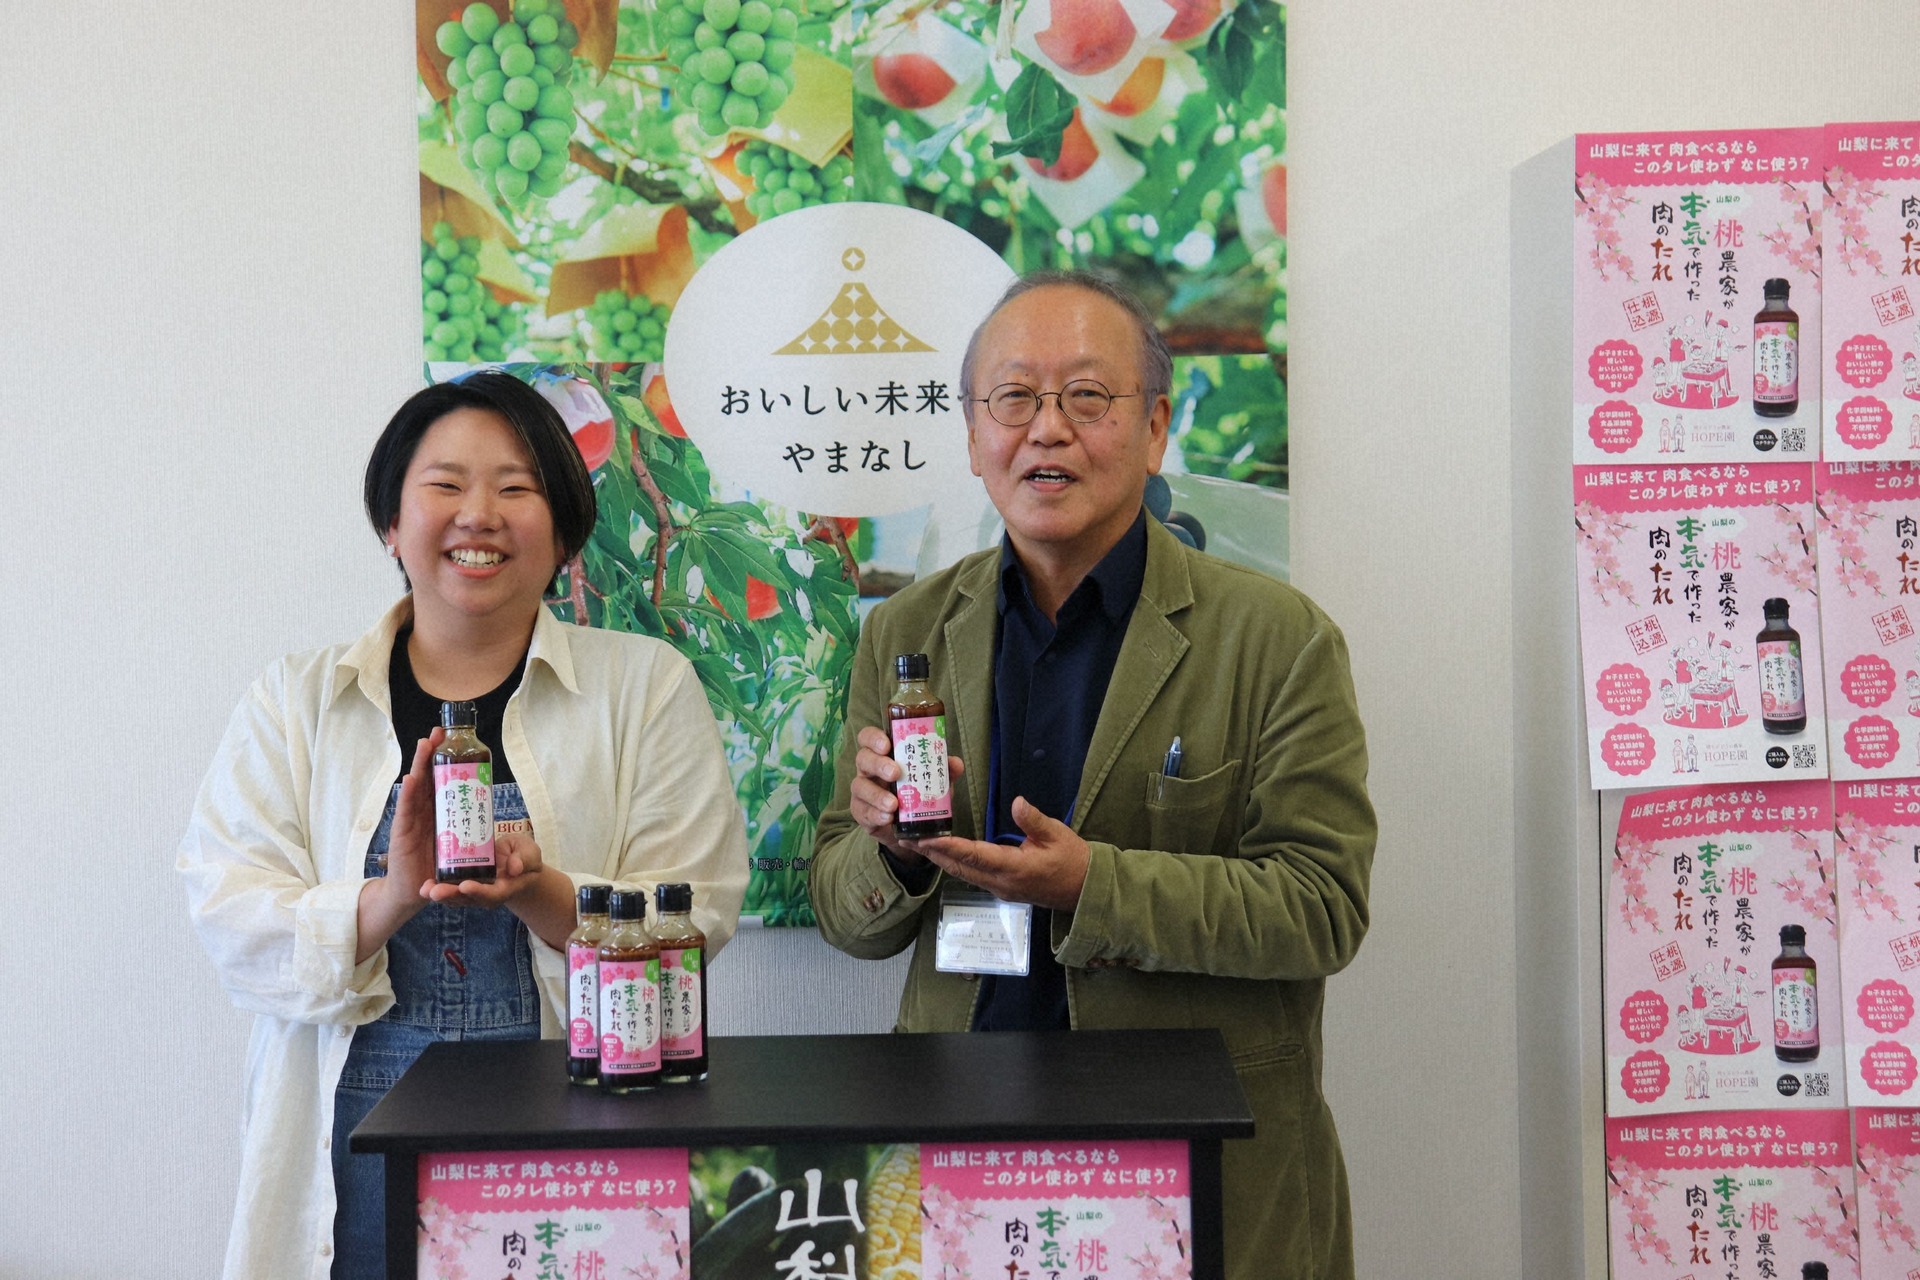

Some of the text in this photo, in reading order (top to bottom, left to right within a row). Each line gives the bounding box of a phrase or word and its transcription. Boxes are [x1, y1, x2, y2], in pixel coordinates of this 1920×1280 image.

[1590, 140, 1757, 158] 山梨に来て 肉食べるなら
[1838, 137, 1914, 152] 山梨に来て
[1633, 158, 1735, 174] このタレ使わず
[1716, 195, 1740, 204] 山梨の
[1650, 201, 1674, 282] 肉のたれ
[1680, 191, 1710, 301] 本気で作った
[1900, 195, 1920, 276] 肉のたれ
[1713, 218, 1745, 309] 桃農家が
[721, 381, 966, 416] おいしい未来
[783, 440, 926, 473] やまなし
[1584, 465, 1750, 486] 山梨に来て 肉食べるなら
[1629, 484, 1728, 500] このタレ使わず
[1711, 518, 1736, 527] 山梨の
[1649, 526, 1674, 605] 肉のたれ
[1896, 515, 1920, 595] 肉のたれ
[1676, 516, 1707, 623] 本気で作った
[1711, 542, 1741, 630] 桃農家が
[905, 743, 918, 783] 肉のたれ
[1704, 750, 1748, 761] HOPE園
[445, 789, 457, 829] 肉のたれ
[1631, 790, 1767, 819] 山梨に来て 肉食べるなら
[498, 822, 522, 833] BIG
[1661, 807, 1746, 828] このタレ使わず
[1729, 843, 1752, 851] 山梨の
[1673, 852, 1694, 931] 肉のたれ
[1697, 841, 1725, 949] 本気で作った
[1728, 867, 1758, 955] 桃農家が
[580, 973, 592, 1016] 肉のたれ
[610, 988, 622, 1031] 肉のたれ
[1620, 1125, 1786, 1142] 山梨に来て 肉食べるなら
[933, 1148, 1120, 1168] 山梨に来て 肉食べるなら
[1664, 1142, 1766, 1157] このタレ使わず
[431, 1160, 620, 1181] 山梨に来て 肉食べるなら
[983, 1168, 1096, 1187] このタレ使わず
[481, 1180, 595, 1199] このタレ使わず
[1748, 1178, 1773, 1187] 山梨の
[1076, 1211, 1103, 1221] 山梨の
[1686, 1184, 1711, 1265] 肉のたれ
[574, 1223, 602, 1232] 山梨の
